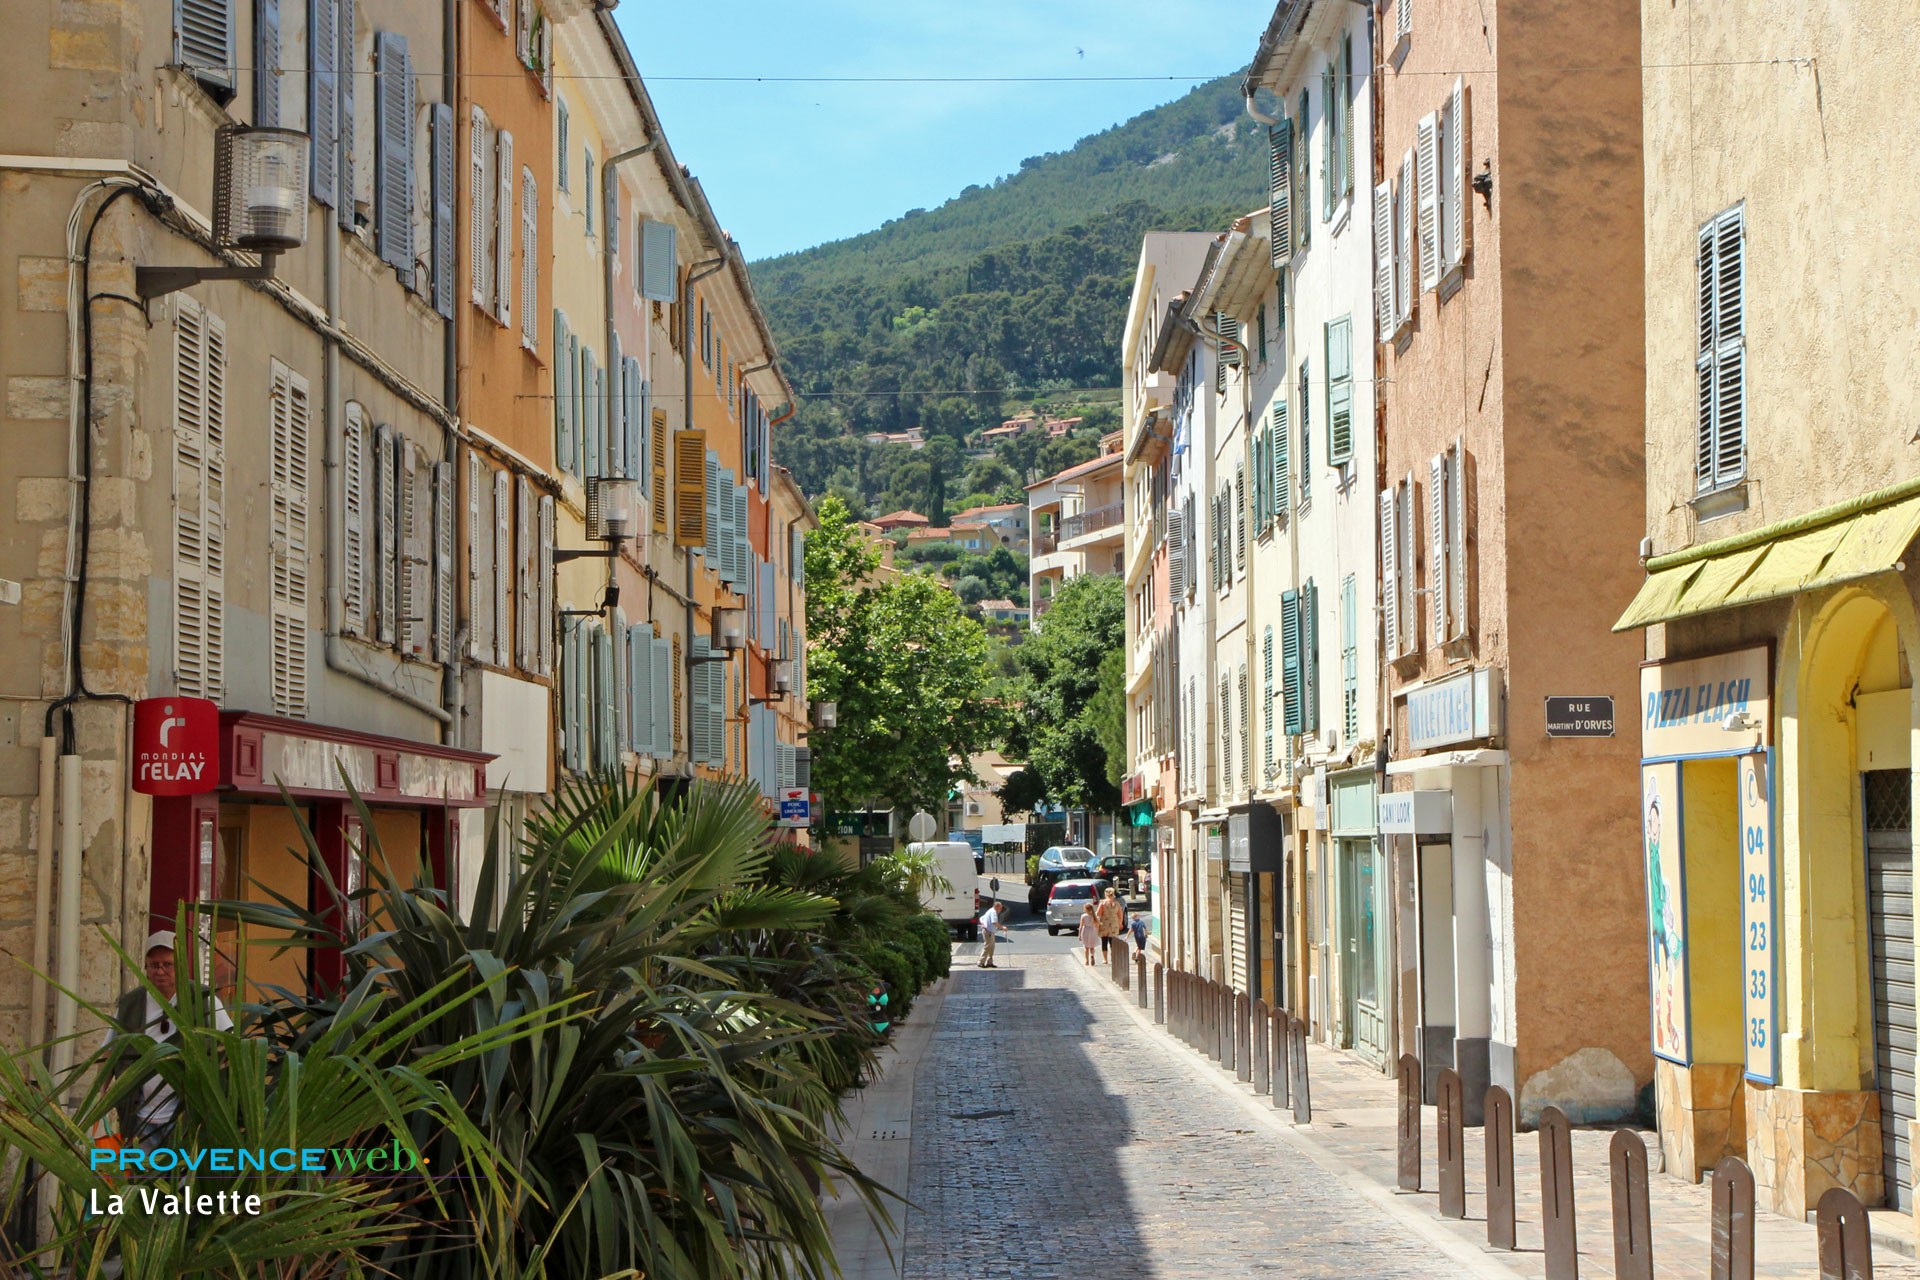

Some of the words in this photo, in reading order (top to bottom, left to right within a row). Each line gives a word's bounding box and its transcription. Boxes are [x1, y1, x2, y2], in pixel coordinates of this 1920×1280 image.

[1409, 684, 1469, 742] TOILETTAGE
[1568, 703, 1591, 713] RUE
[1645, 687, 1691, 731] PIZZA
[1694, 679, 1751, 724] FLASH
[1547, 722, 1575, 731] MARTINY
[1575, 719, 1613, 731] D'ORVES
[1747, 825, 1764, 855] 04
[1749, 873, 1766, 903] 94
[1750, 921, 1767, 951] 23
[1750, 969, 1767, 1000] 33
[1750, 1017, 1766, 1049] 35
